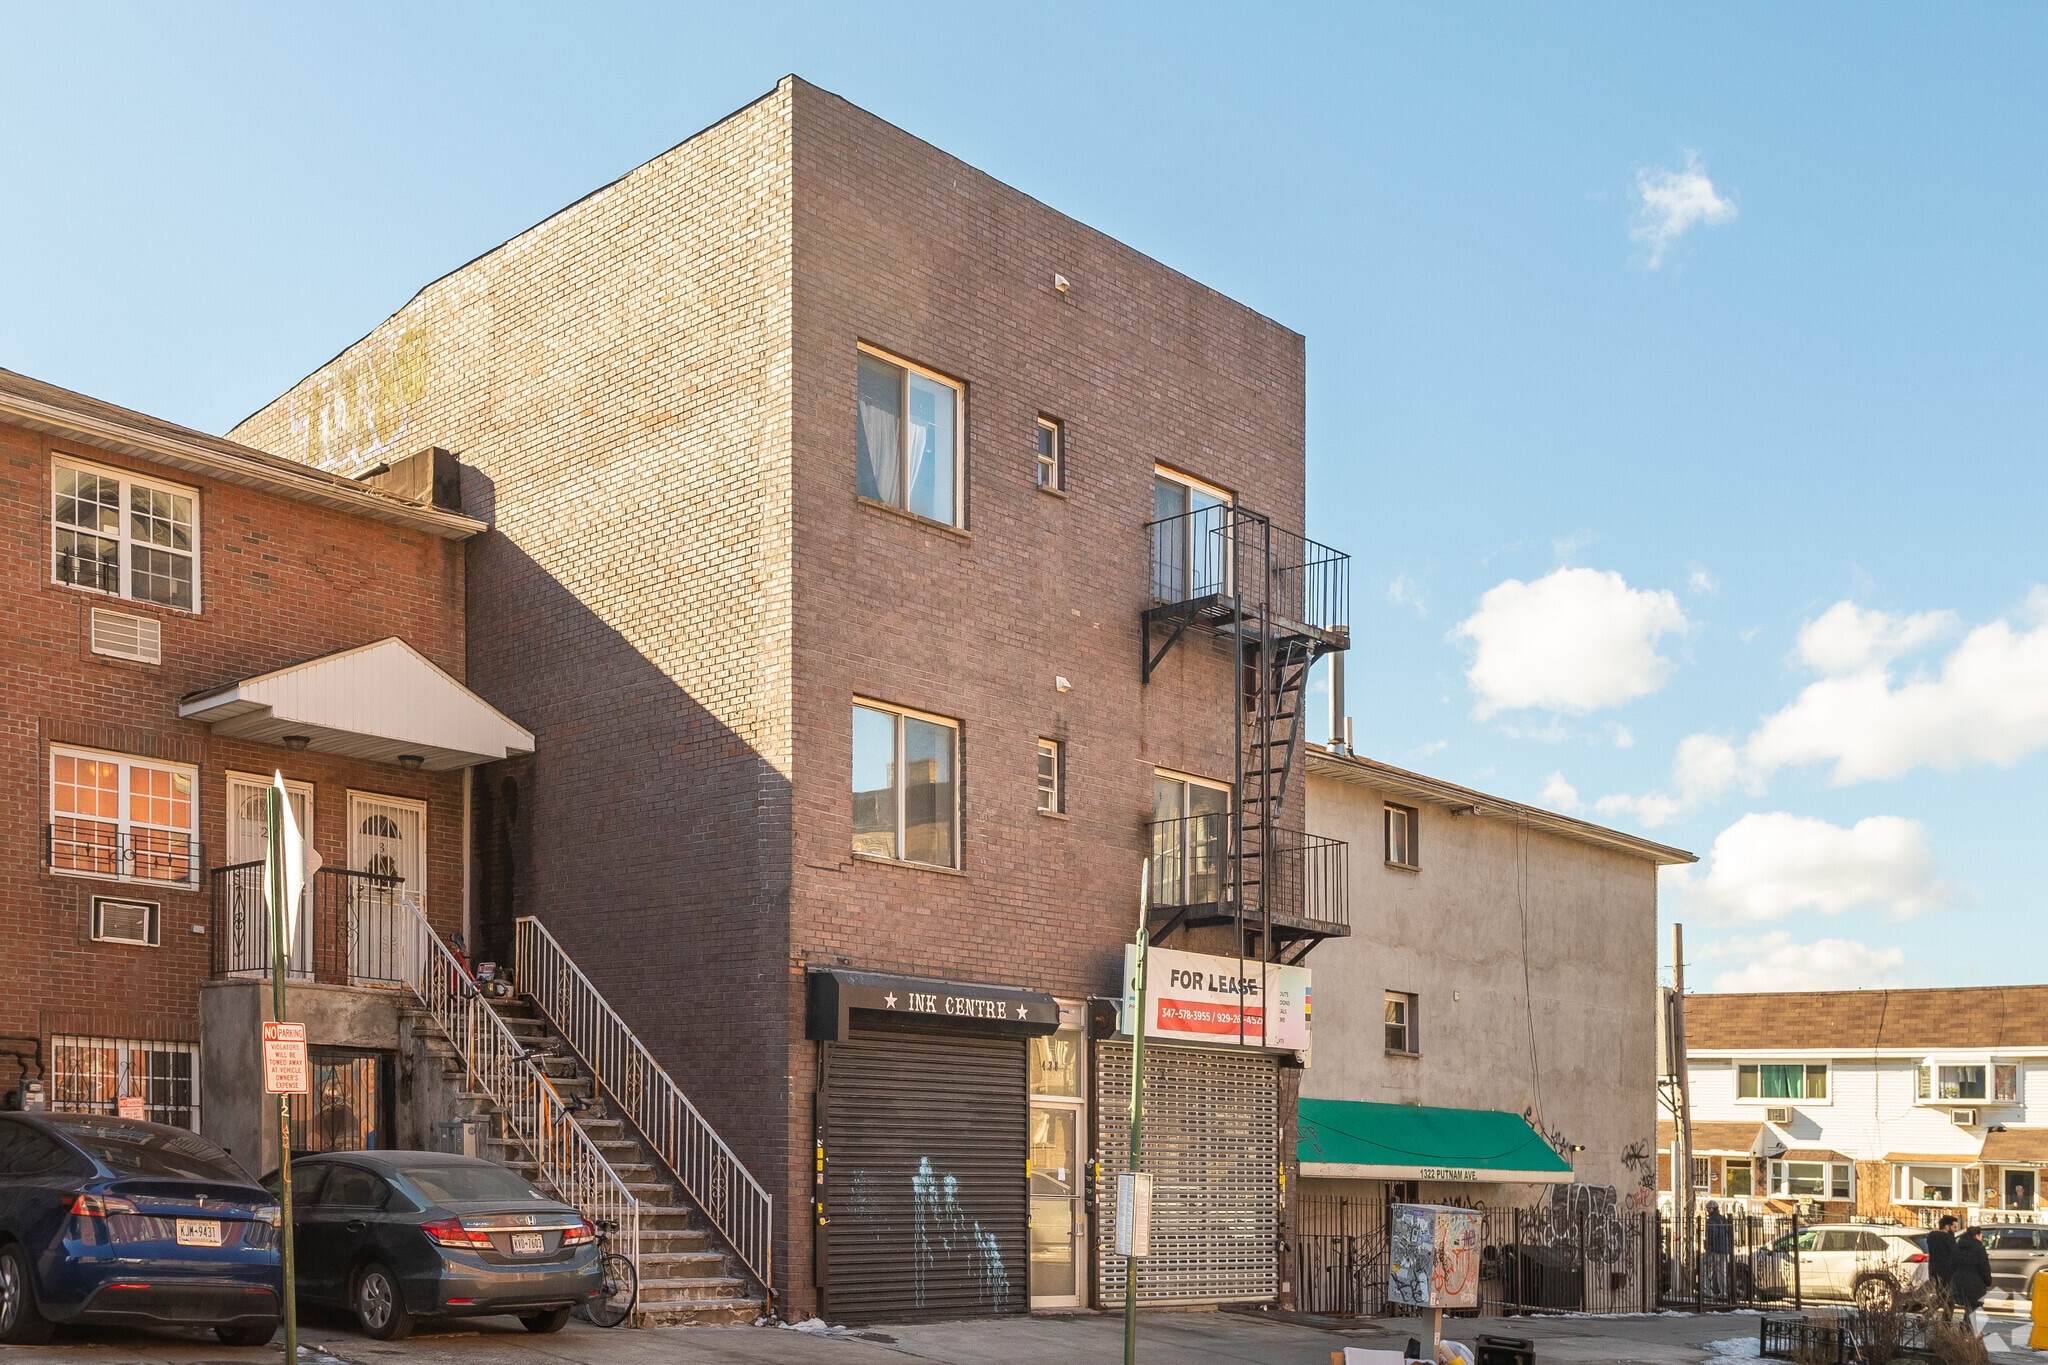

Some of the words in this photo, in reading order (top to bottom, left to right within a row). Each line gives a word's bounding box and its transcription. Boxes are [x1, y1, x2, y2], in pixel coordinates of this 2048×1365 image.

[1170, 968, 1203, 991] FOR
[1208, 974, 1258, 996] LEASE
[908, 992, 937, 1014] INK
[945, 996, 1007, 1019] CENTRE
[1161, 1007, 1211, 1022] 347-578-3955
[264, 1026, 277, 1039] NO
[278, 1028, 303, 1039] PARKING
[1420, 1168, 1435, 1179] 1322
[1436, 1169, 1463, 1180] PUTNAM
[1463, 1170, 1478, 1181] AVE.
